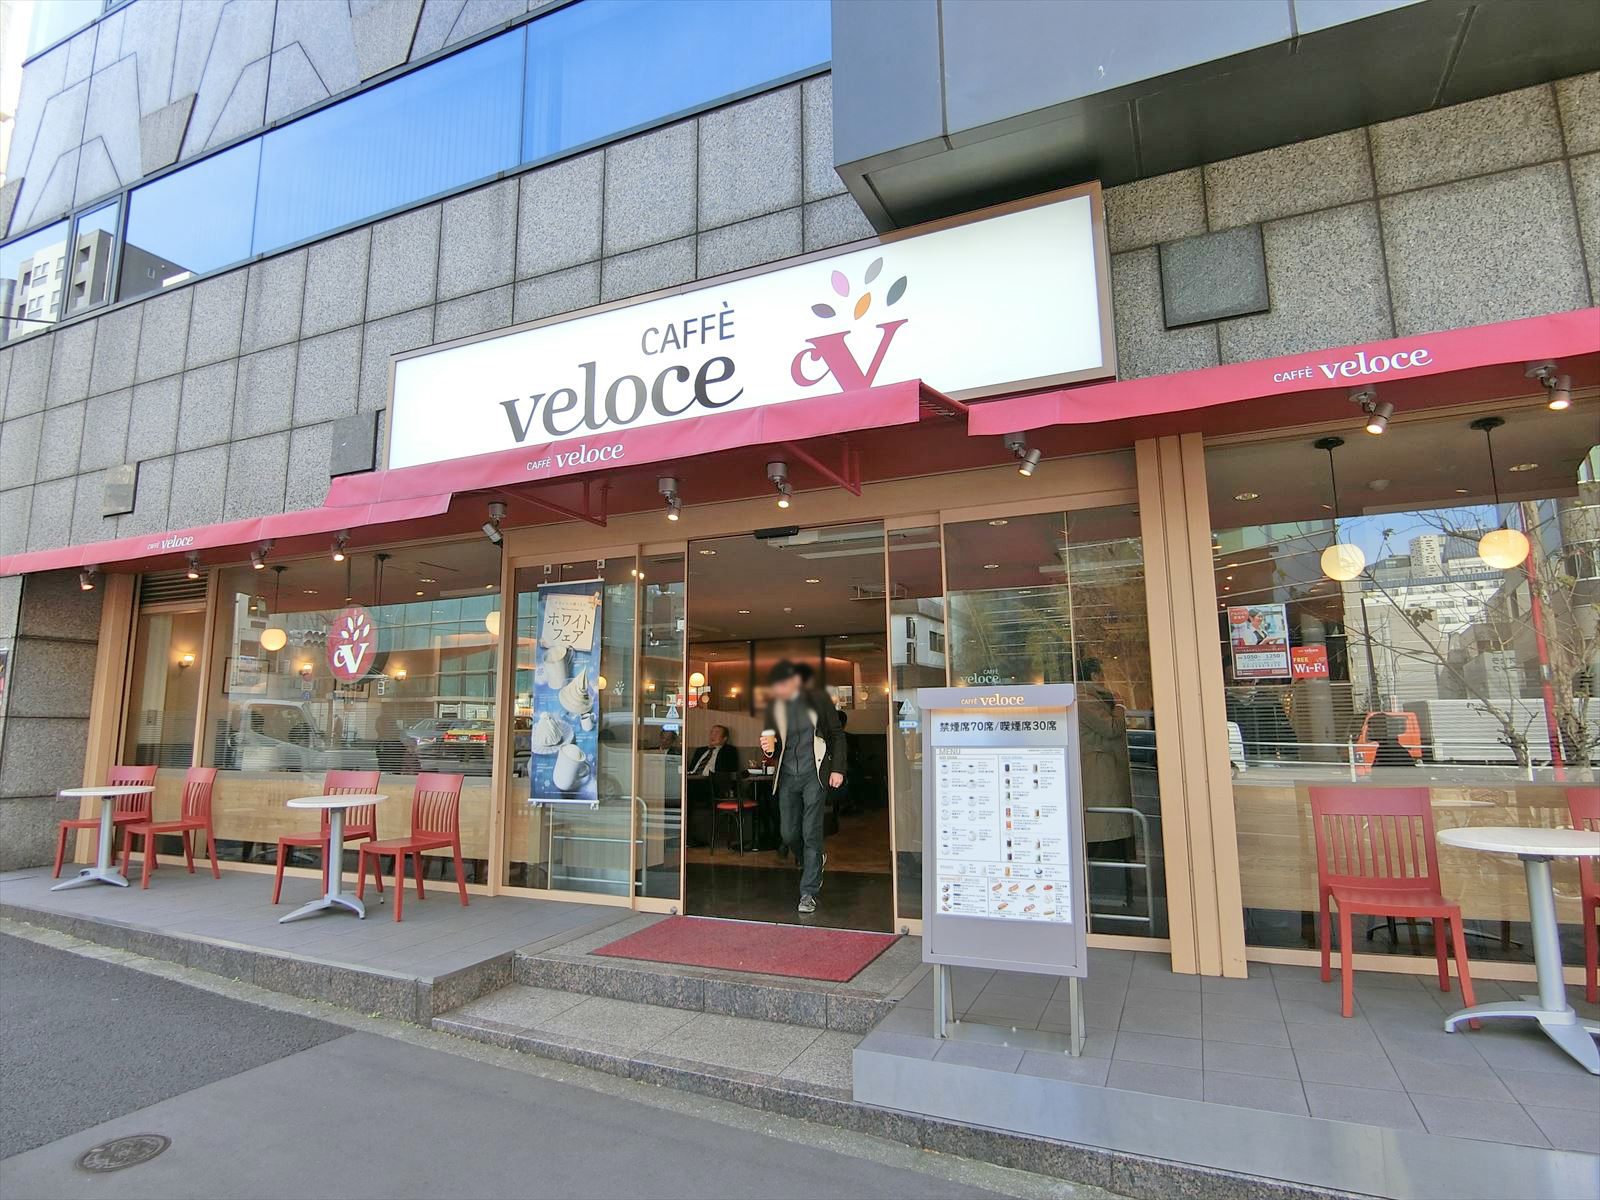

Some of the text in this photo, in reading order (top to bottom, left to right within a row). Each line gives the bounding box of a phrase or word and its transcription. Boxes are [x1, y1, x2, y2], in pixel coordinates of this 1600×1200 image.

[641, 301, 735, 356] CAFFÈ
[1273, 349, 1433, 383] CAFFÈ veloce
[499, 356, 744, 443] veloce
[526, 443, 625, 471] CAFFÈ veloce
[161, 534, 194, 549] veloce
[547, 612, 591, 630] ホワイト
[552, 628, 584, 643] フェア
[960, 673, 1000, 684] veloce
[980, 693, 1025, 706] veloce
